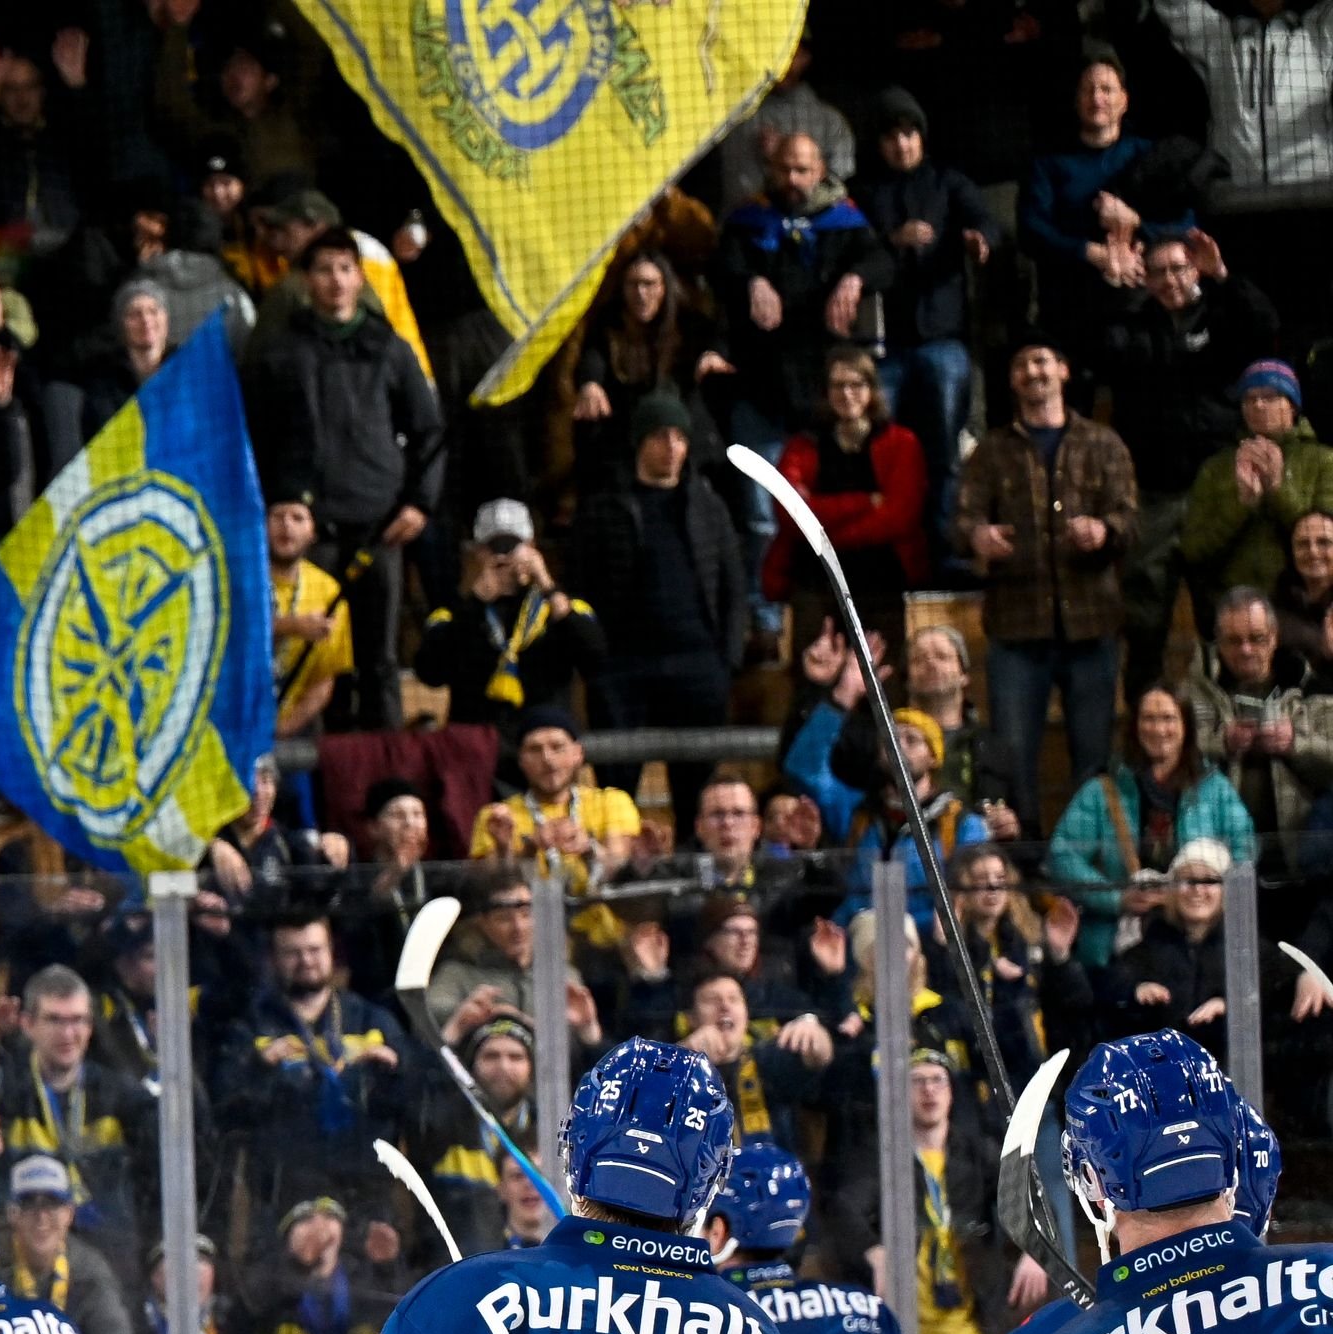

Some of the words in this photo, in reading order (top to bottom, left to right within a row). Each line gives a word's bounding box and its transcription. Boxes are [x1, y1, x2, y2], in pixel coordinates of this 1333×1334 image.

[600, 1081, 621, 1101] 25
[1113, 1088, 1137, 1114] 77
[685, 1106, 706, 1131] 25
[1254, 1150, 1269, 1168] 70
[612, 1235, 711, 1266] enovetic
[1134, 1230, 1235, 1273] enovetic
[613, 1263, 639, 1275] new
[642, 1265, 694, 1281] balance
[1142, 1283, 1169, 1299] new
[1170, 1264, 1226, 1288] balance
[749, 1283, 883, 1322] khalter
